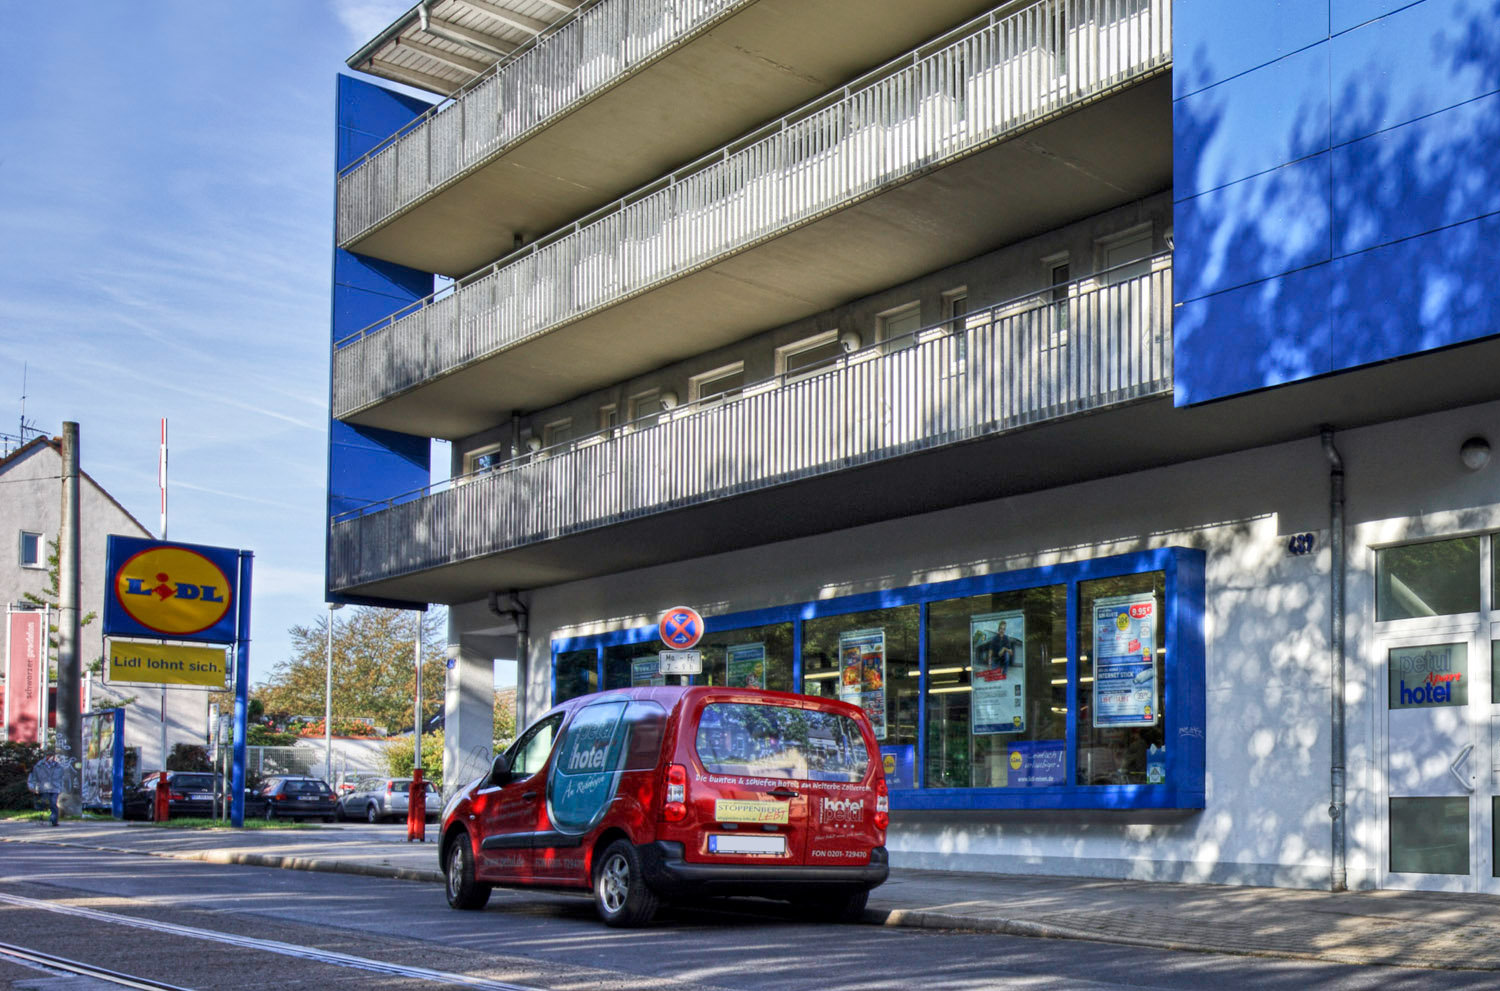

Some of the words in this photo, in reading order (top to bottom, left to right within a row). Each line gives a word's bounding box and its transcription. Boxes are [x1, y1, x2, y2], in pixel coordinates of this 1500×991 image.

[114, 656, 141, 668] Lidl
[147, 658, 184, 671] lohnt
[189, 661, 222, 673] sich.
[1400, 648, 1452, 680] petul
[1423, 671, 1462, 686] Apart
[1400, 679, 1452, 705] hotel
[571, 743, 609, 770] hotel
[695, 774, 707, 782] Die
[709, 775, 736, 785] bunten
[739, 777, 745, 785] &
[745, 778, 777, 788] schiefen
[812, 783, 841, 791] Welterbe
[824, 797, 864, 814] hotel
[824, 808, 864, 824] petul
[812, 849, 826, 857] FON
